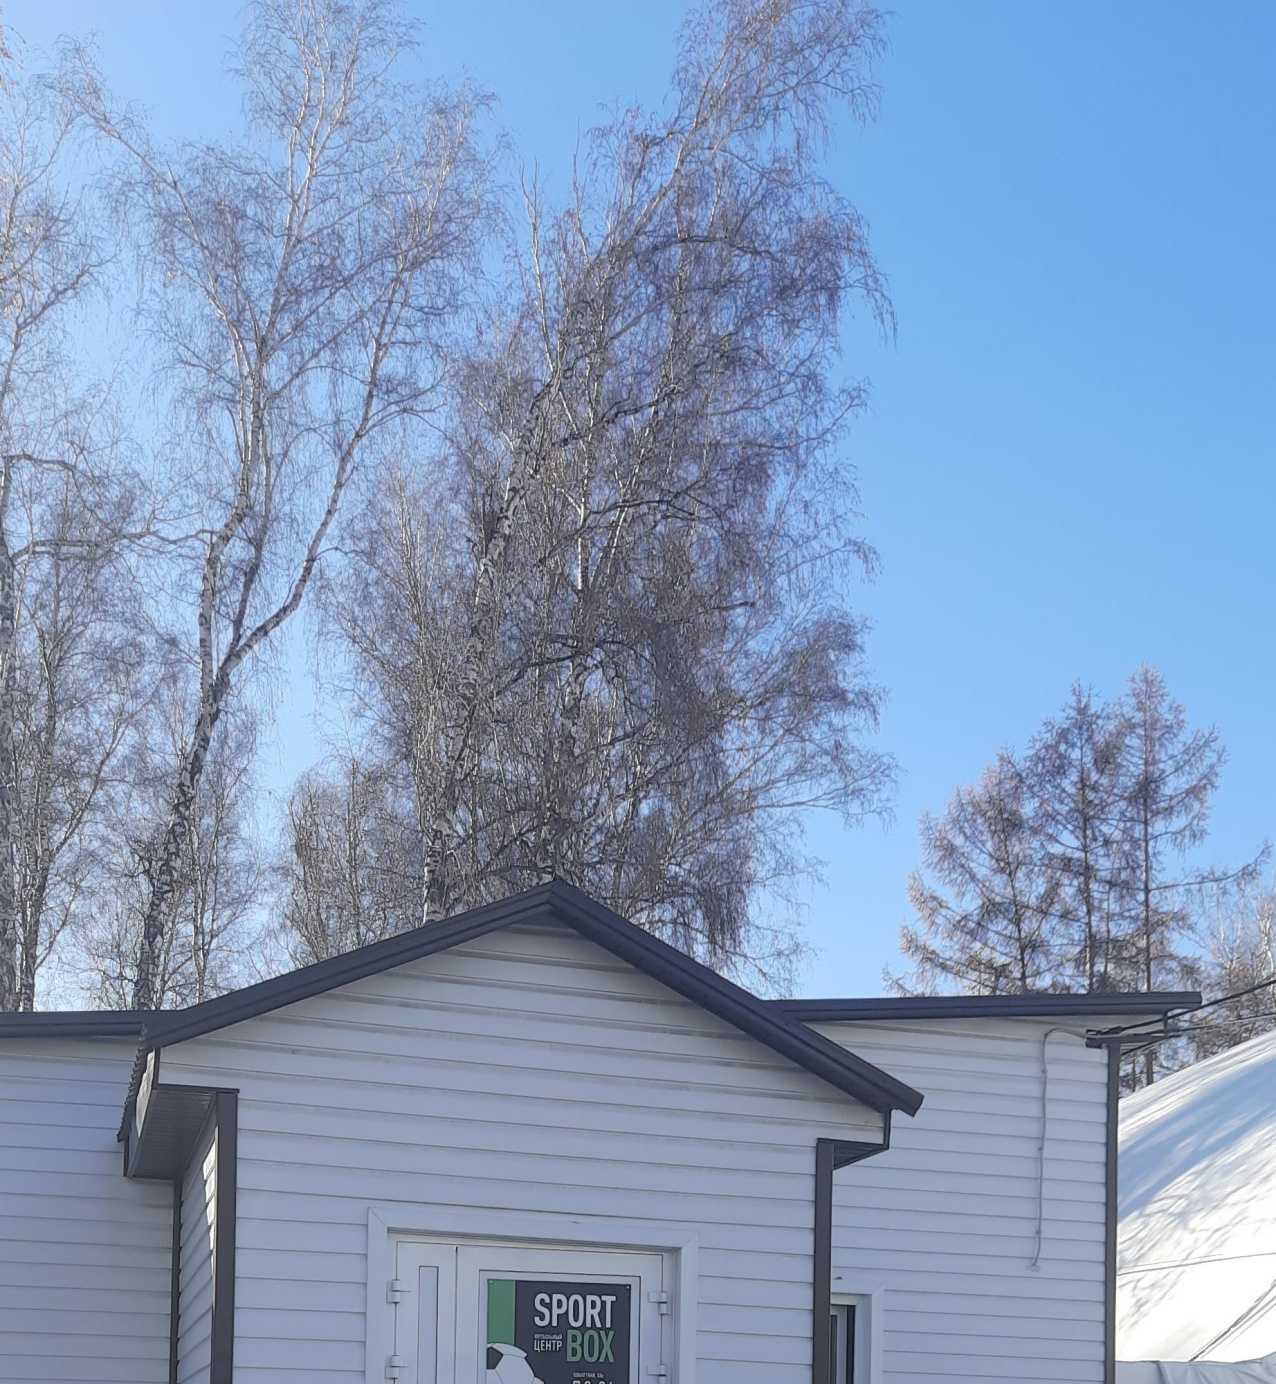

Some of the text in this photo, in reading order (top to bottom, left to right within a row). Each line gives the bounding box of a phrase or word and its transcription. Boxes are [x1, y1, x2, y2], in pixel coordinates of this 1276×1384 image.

[534, 1293, 616, 1328] SPORT
[534, 1339, 563, 1352] ЦЕНТР
[566, 1329, 615, 1363] BOX
